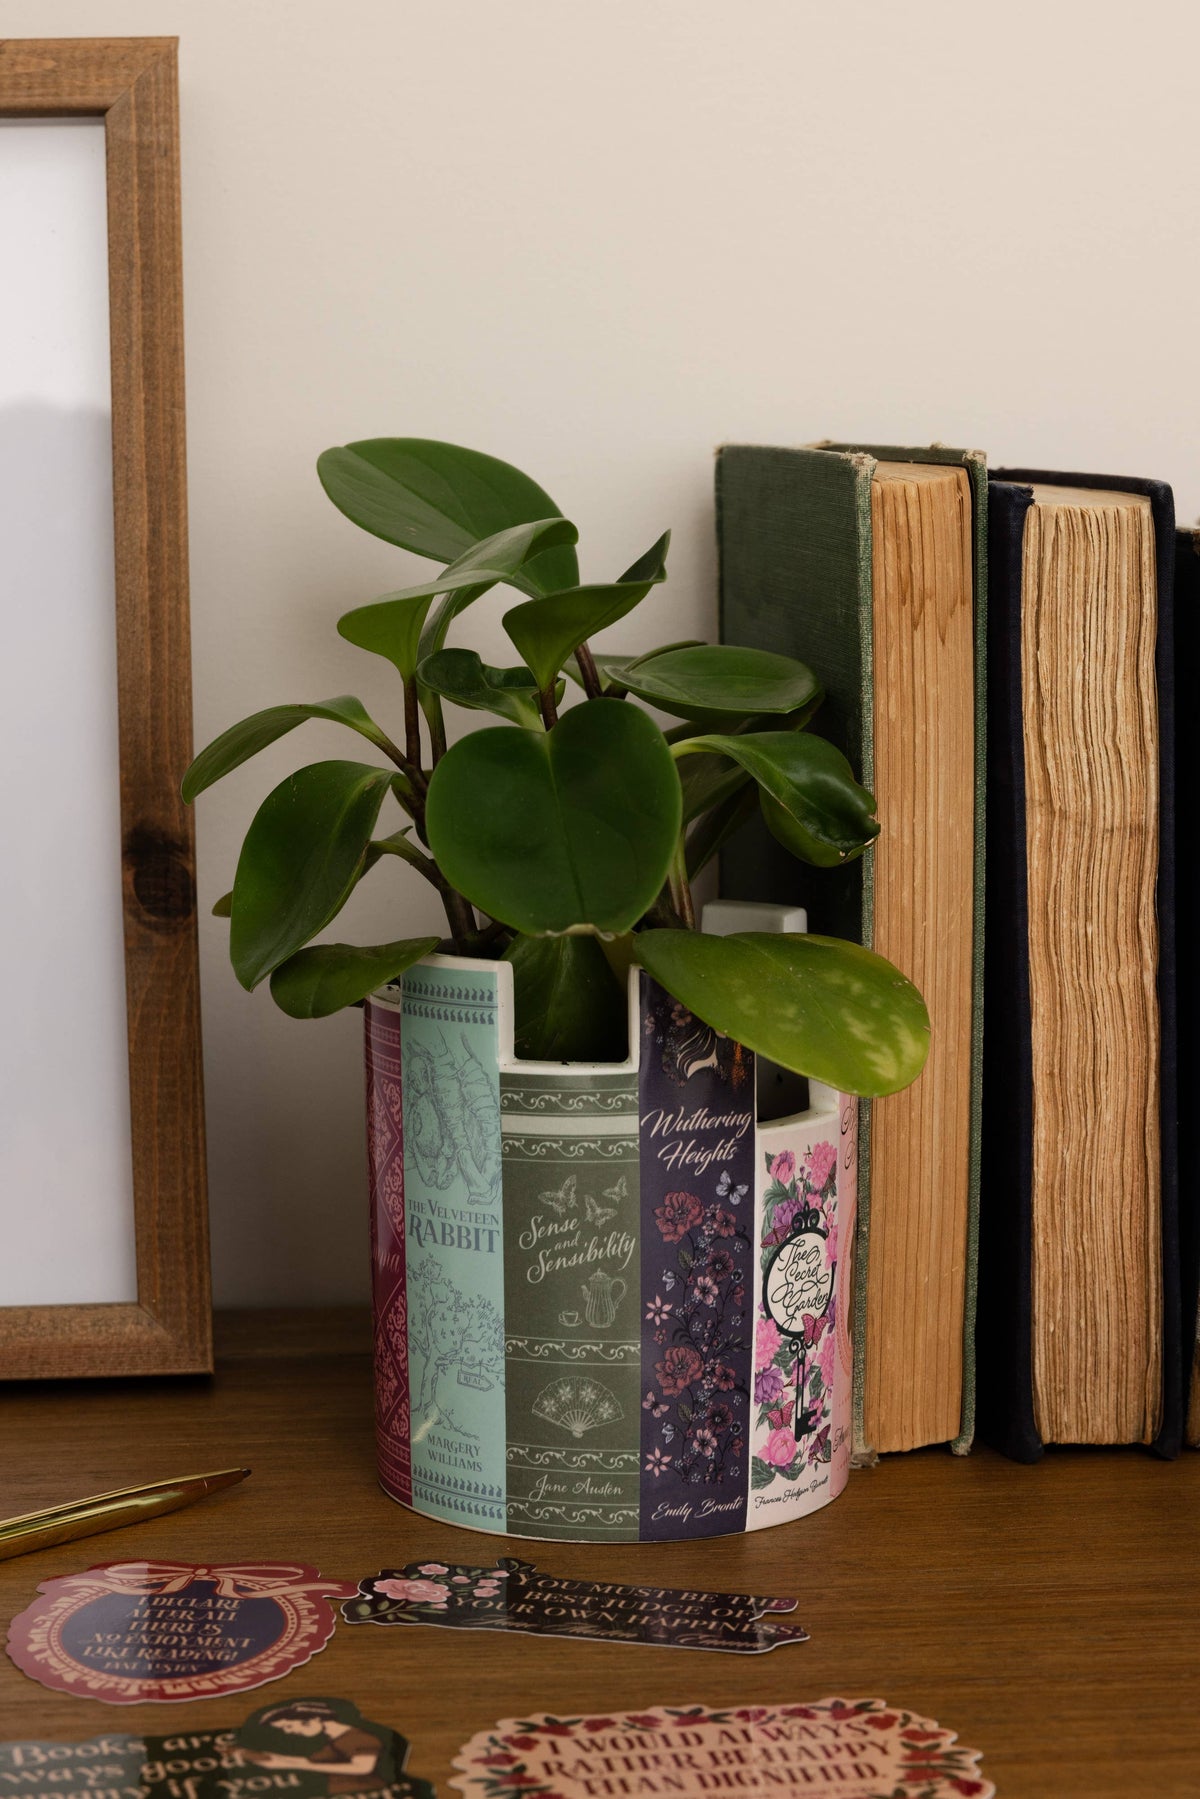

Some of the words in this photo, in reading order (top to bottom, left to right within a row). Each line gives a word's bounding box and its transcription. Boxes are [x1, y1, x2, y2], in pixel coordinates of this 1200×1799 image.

[640, 1106, 752, 1138] Wuthering
[657, 1138, 740, 1176] Heights
[407, 1199, 426, 1214] THE
[427, 1199, 499, 1226] VELVETEEN
[408, 1213, 500, 1253] RABBIT
[519, 1215, 580, 1250] Sense
[554, 1230, 581, 1251] and
[527, 1231, 636, 1284] Sensibility
[777, 1239, 821, 1271] The
[771, 1260, 830, 1303] Secret
[782, 1280, 830, 1330] Garden
[427, 1434, 481, 1458] MARGERY
[427, 1449, 483, 1472] WILLIAMS
[528, 1474, 568, 1502] Jane
[572, 1477, 625, 1496] Austen
[651, 1503, 693, 1523] Emily
[150, 1598, 243, 1610] DECLARE
[514, 1573, 582, 1590] YOU
[590, 1584, 673, 1599] MUST
[680, 1591, 718, 1602] BE
[728, 1595, 790, 1608] THE
[524, 1591, 598, 1606] BEST
[601, 1598, 703, 1614] JUDGE
[711, 1607, 755, 1618] OF
[455, 1597, 535, 1614] YOUR
[544, 1607, 618, 1622] OWN
[125, 1632, 255, 1649] ENJOYMENT
[573, 1732, 704, 1752] WOULD
[717, 1724, 870, 1744] ALWAYS
